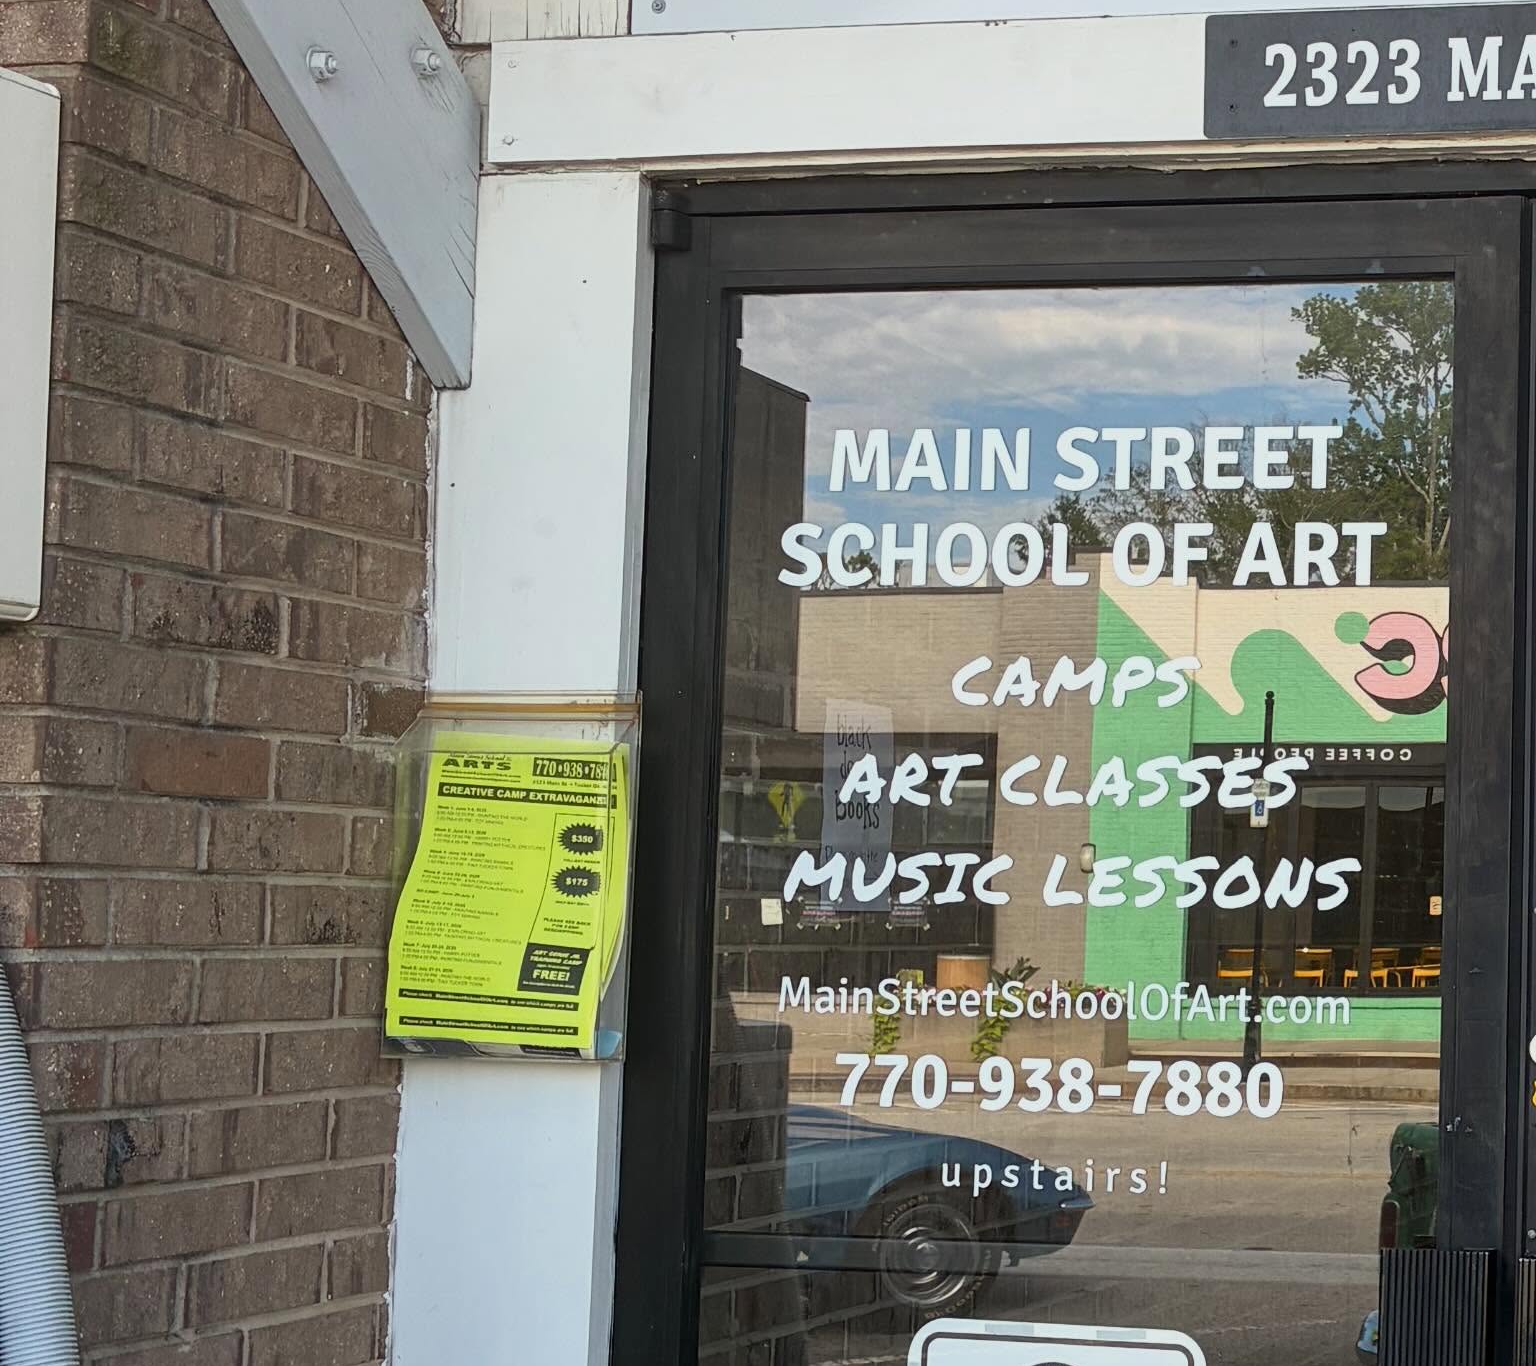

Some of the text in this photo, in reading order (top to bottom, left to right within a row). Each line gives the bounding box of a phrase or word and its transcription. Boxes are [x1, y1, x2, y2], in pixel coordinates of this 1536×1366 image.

[1262, 39, 1421, 108] 2323
[829, 425, 1343, 492] MAIN STREET
[778, 522, 1388, 587] SCHOOL OF ART
[951, 655, 1202, 708] CAMPS
[442, 758, 511, 771] ARTS
[838, 753, 1310, 808] ART CLASSES
[443, 785, 494, 797] CREATIVE
[496, 788, 527, 799] CAMP
[571, 834, 594, 844] $350
[565, 877, 588, 887] $175
[783, 849, 1014, 905] MUSIC
[1043, 855, 1362, 911] LESSONS
[532, 969, 570, 982] FREE!
[779, 975, 1351, 1026] MainStreetSchoolOfArt.com
[836, 1052, 1284, 1119] 770-938-7880
[941, 1159, 1170, 1196] upstairs!
